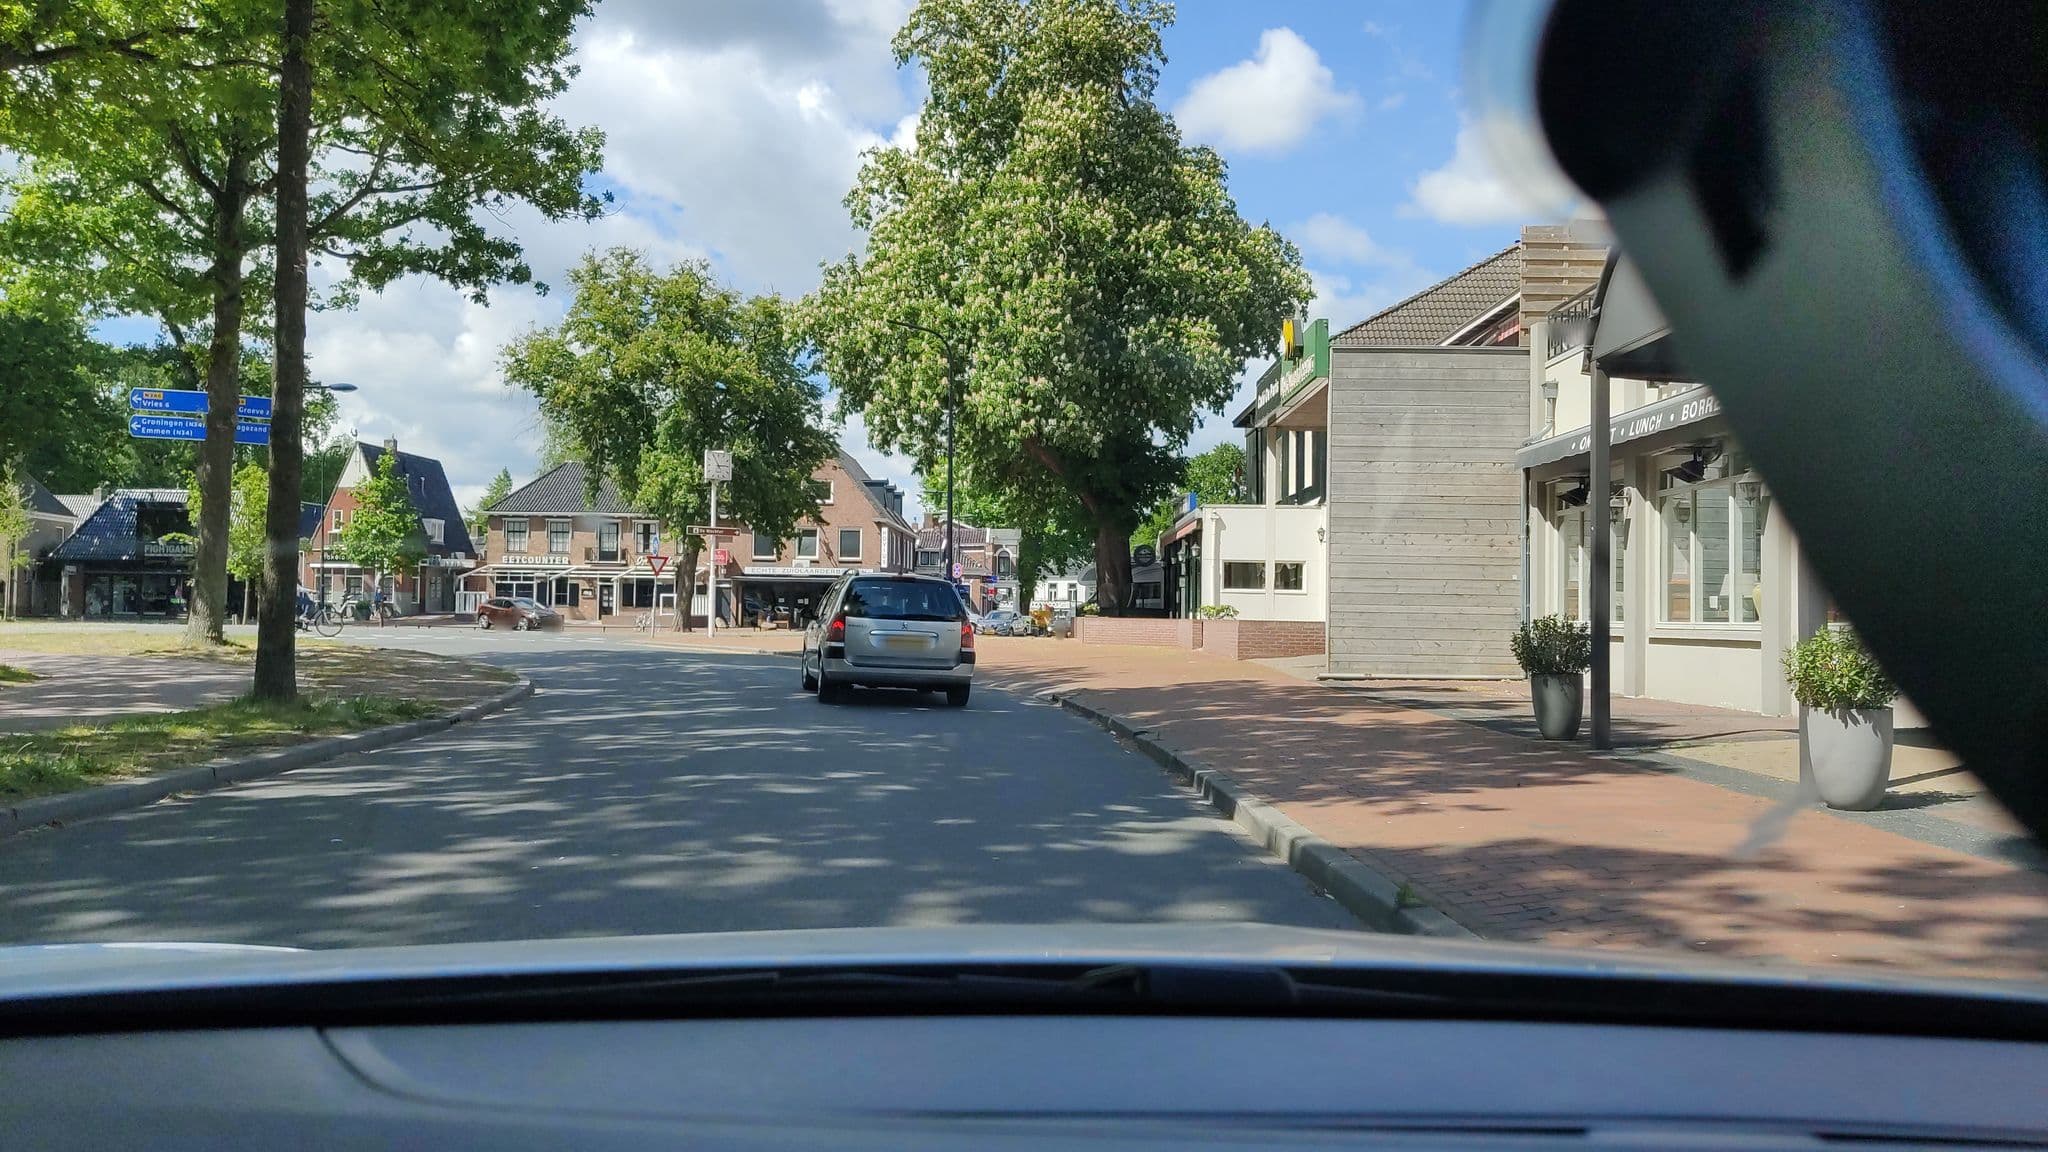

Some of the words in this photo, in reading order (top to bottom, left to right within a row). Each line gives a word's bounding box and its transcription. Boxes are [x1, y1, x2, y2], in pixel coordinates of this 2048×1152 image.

[142, 400, 163, 408] Vries
[1629, 413, 1663, 437] LUNCH
[1681, 396, 1721, 421] BORRE
[141, 418, 184, 428] Groningen
[141, 427, 171, 435] Emmen
[502, 555, 569, 565] EETCOUNTER
